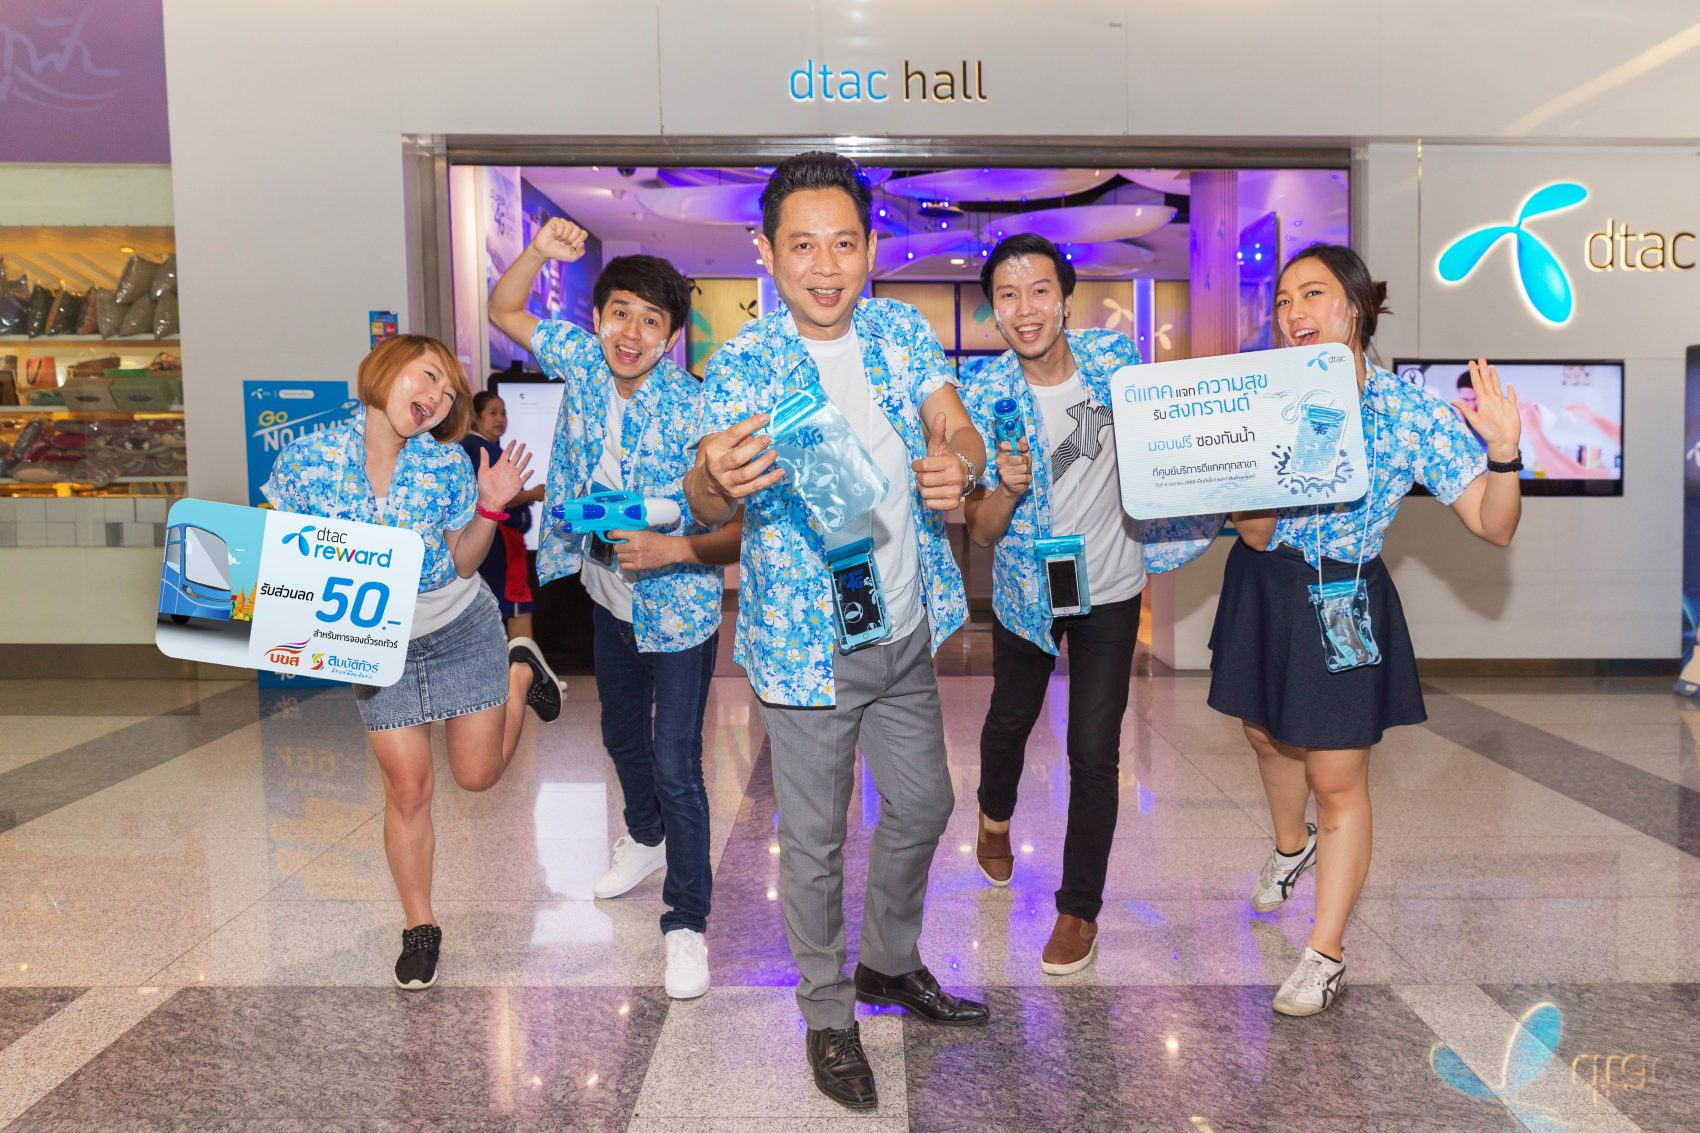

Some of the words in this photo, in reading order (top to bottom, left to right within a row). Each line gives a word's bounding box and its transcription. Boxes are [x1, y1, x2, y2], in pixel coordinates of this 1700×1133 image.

[789, 58, 889, 103] dtac
[903, 59, 988, 103] hall
[1584, 218, 1698, 272] dtac
[1328, 354, 1346, 364] dtac
[1124, 384, 1173, 403] ดีแทค
[1175, 387, 1196, 398] แจก
[1197, 374, 1268, 396] ความสุข
[1153, 409, 1167, 421] รับ
[1168, 393, 1250, 419] สงกรานต์
[803, 427, 824, 451] 4G
[1148, 434, 1193, 452] มอบฟรี
[1196, 426, 1256, 447] ซองกันน้ำ
[316, 527, 348, 544] dtac
[314, 544, 393, 568] reward
[260, 583, 315, 602] รับส่วนลด
[847, 576, 864, 593] 4G
[313, 629, 399, 649] สำหรับการจองตั๋วรถทัวร์
[270, 652, 300, 668] บขส
